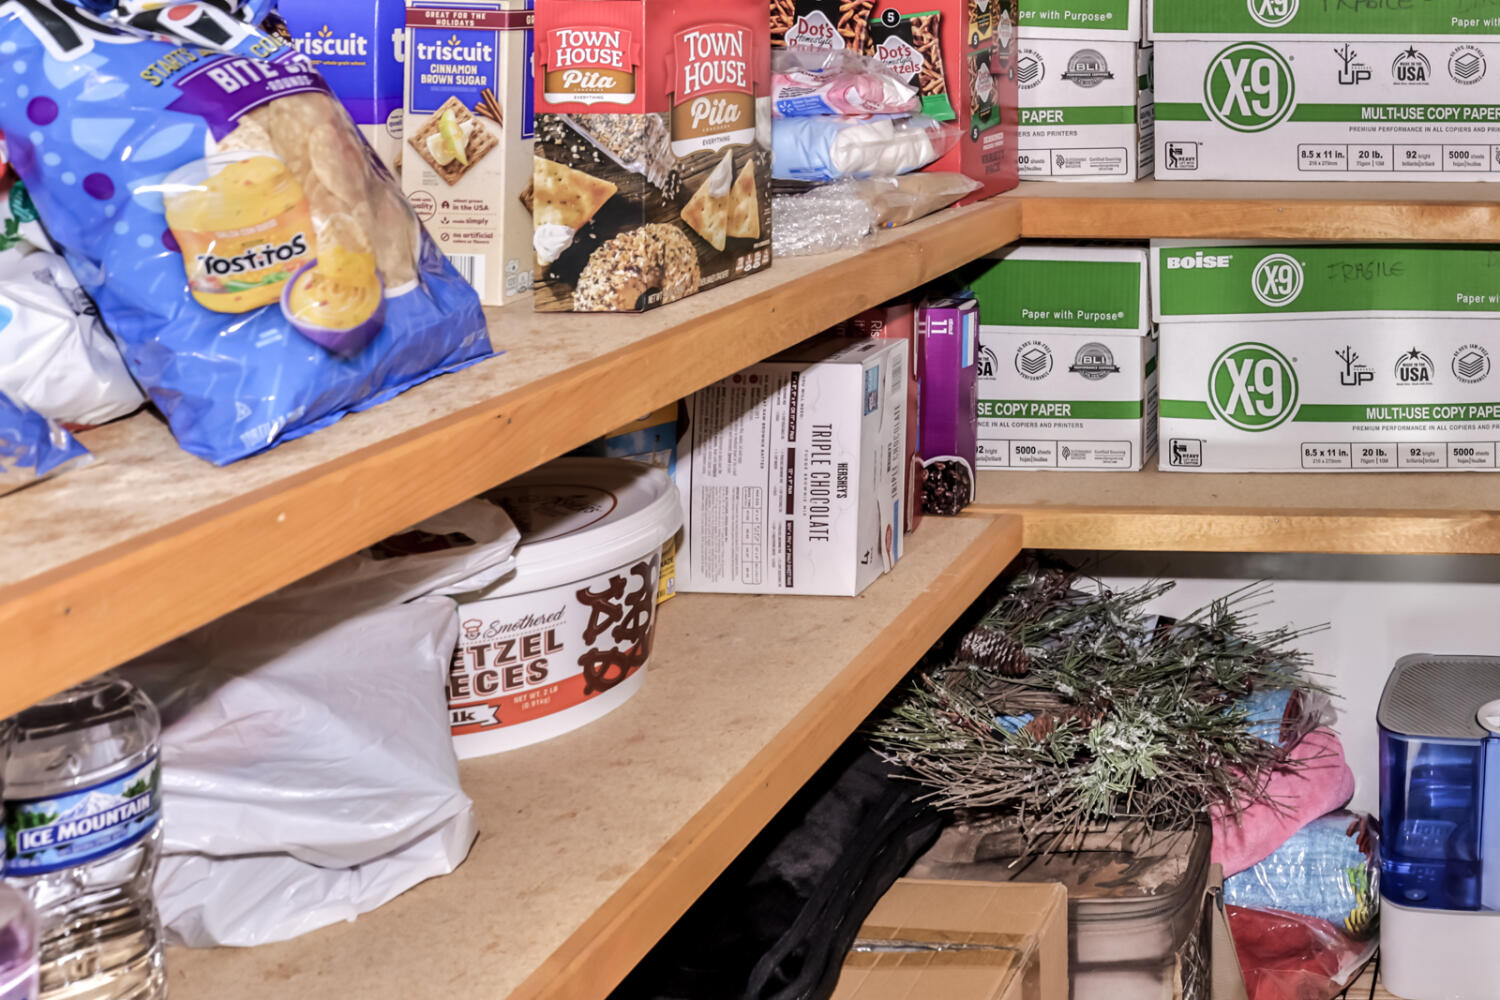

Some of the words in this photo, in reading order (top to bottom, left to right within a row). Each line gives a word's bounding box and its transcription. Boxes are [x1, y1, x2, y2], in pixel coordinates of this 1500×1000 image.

[425, 10, 450, 20] GREAT
[453, 11, 468, 20] FOR
[471, 12, 487, 21] THE
[1039, 10, 1061, 20] with
[1451, 17, 1480, 28] Paper
[436, 19, 475, 27] HOLIDAYS
[798, 17, 834, 39] Dot's
[556, 28, 621, 50] TOWN
[683, 30, 744, 63] TOWN
[417, 42, 493, 63] triscuit
[556, 47, 624, 69] HOUSE
[878, 43, 912, 61] Dot's
[141, 48, 198, 87] STARTS
[207, 56, 280, 94] BITE
[430, 63, 478, 76] CINNAMON
[1397, 66, 1427, 82] USA
[421, 74, 454, 86] BROWN
[456, 75, 487, 87] SUGAR
[562, 69, 617, 90] Pita
[684, 60, 747, 97] HOUSE
[1338, 69, 1372, 86] UP
[1220, 57, 1280, 117] X-9
[690, 94, 742, 131] Pita
[1021, 110, 1064, 124] PAPER
[1361, 107, 1425, 121] MULTI-USE
[1427, 107, 1463, 120] COPY
[702, 133, 732, 147] EVERYTHING
[1301, 150, 1314, 159] 8.5
[1335, 150, 1346, 159] in.
[1358, 151, 1371, 159] 20
[1372, 151, 1383, 159] lb.
[1406, 151, 1417, 159] 92
[1449, 151, 1470, 159] 5000
[474, 203, 489, 211] USA
[466, 217, 489, 227] simply
[463, 232, 493, 240] artificial
[1167, 252, 1230, 269] BOISE
[1263, 264, 1294, 295] X-9
[1456, 293, 1485, 304] Paper
[1021, 309, 1050, 320] Paper
[1053, 309, 1074, 319] with
[931, 319, 947, 335] 11
[1340, 371, 1375, 387] UP
[1400, 367, 1429, 382] USA
[1224, 358, 1283, 417] X-9
[994, 402, 1029, 416] COPY
[1030, 403, 1072, 417] PAPER
[1366, 406, 1430, 420] MULTI-USE
[1432, 406, 1467, 419] COPY
[811, 423, 833, 467] TRIPLE
[1015, 446, 1037, 455] 5000
[1362, 448, 1374, 457] 20
[1375, 448, 1387, 457] lb.
[1409, 448, 1422, 457] 92
[1453, 448, 1475, 457] 5000
[1305, 449, 1320, 457] 8.5
[836, 462, 849, 499] HERSHEY'S
[808, 470, 832, 543] CHOCOLATE
[483, 604, 567, 639] Smothered
[22, 828, 55, 849] ICE
[56, 794, 150, 842] MOUNTAIN
